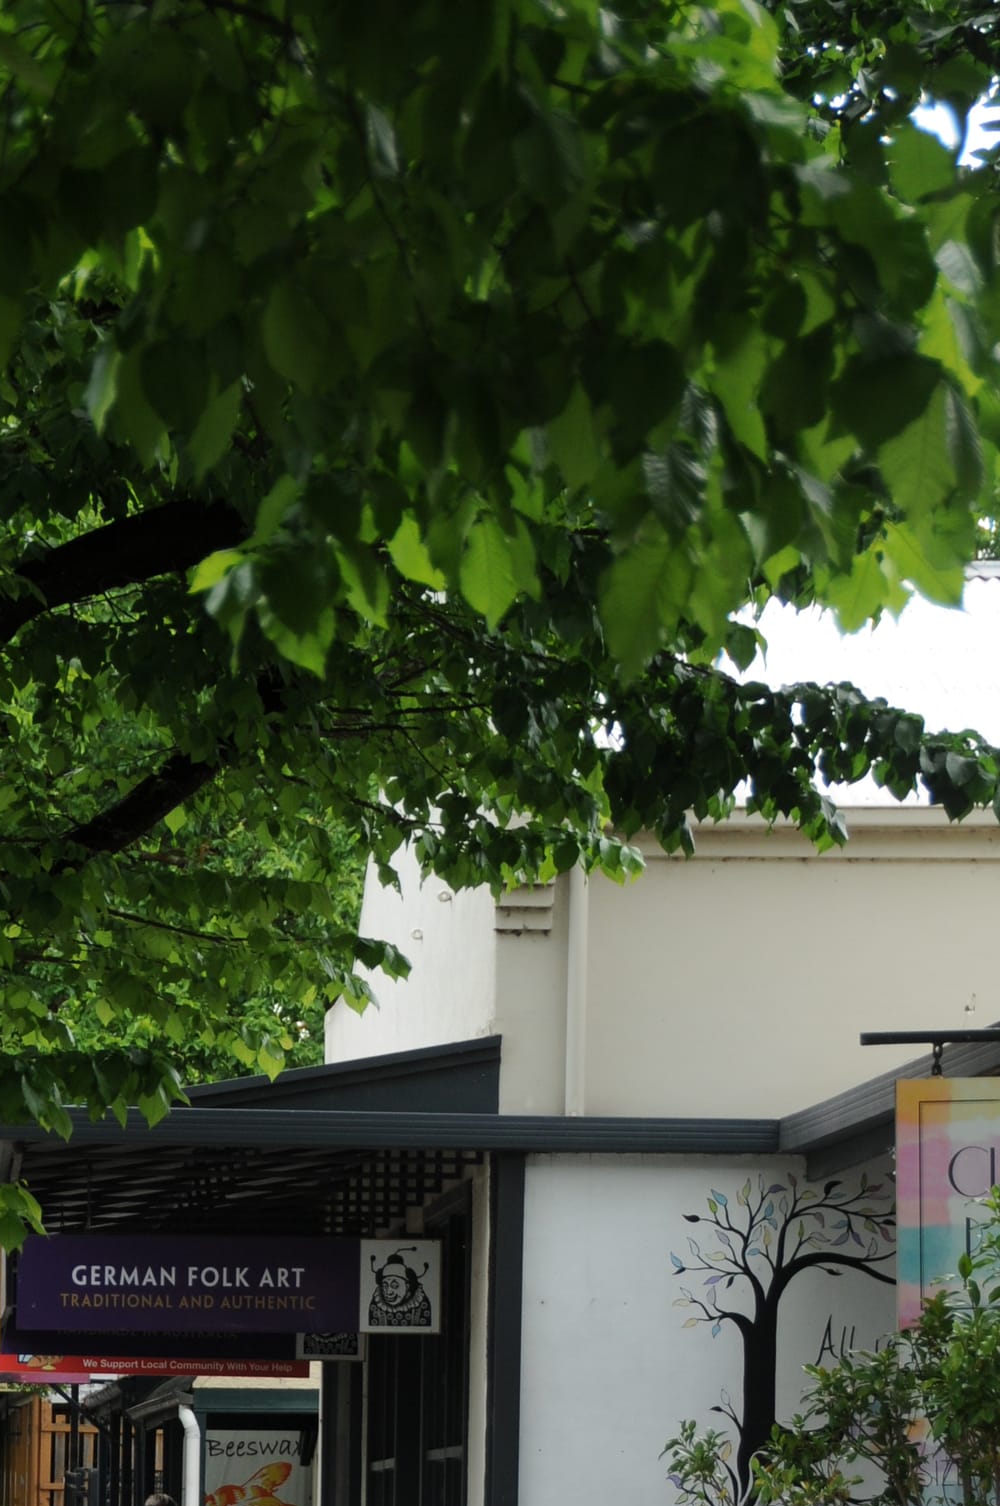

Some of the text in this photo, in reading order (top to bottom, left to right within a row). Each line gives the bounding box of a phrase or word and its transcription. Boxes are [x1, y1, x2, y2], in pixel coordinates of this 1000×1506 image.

[71, 1264, 305, 1288] GERMAN FOLK ART
[60, 1293, 316, 1311] TRADITIONAL AND AUTHENTIC
[82, 1358, 293, 1374] We Support Local Community With Your Help
